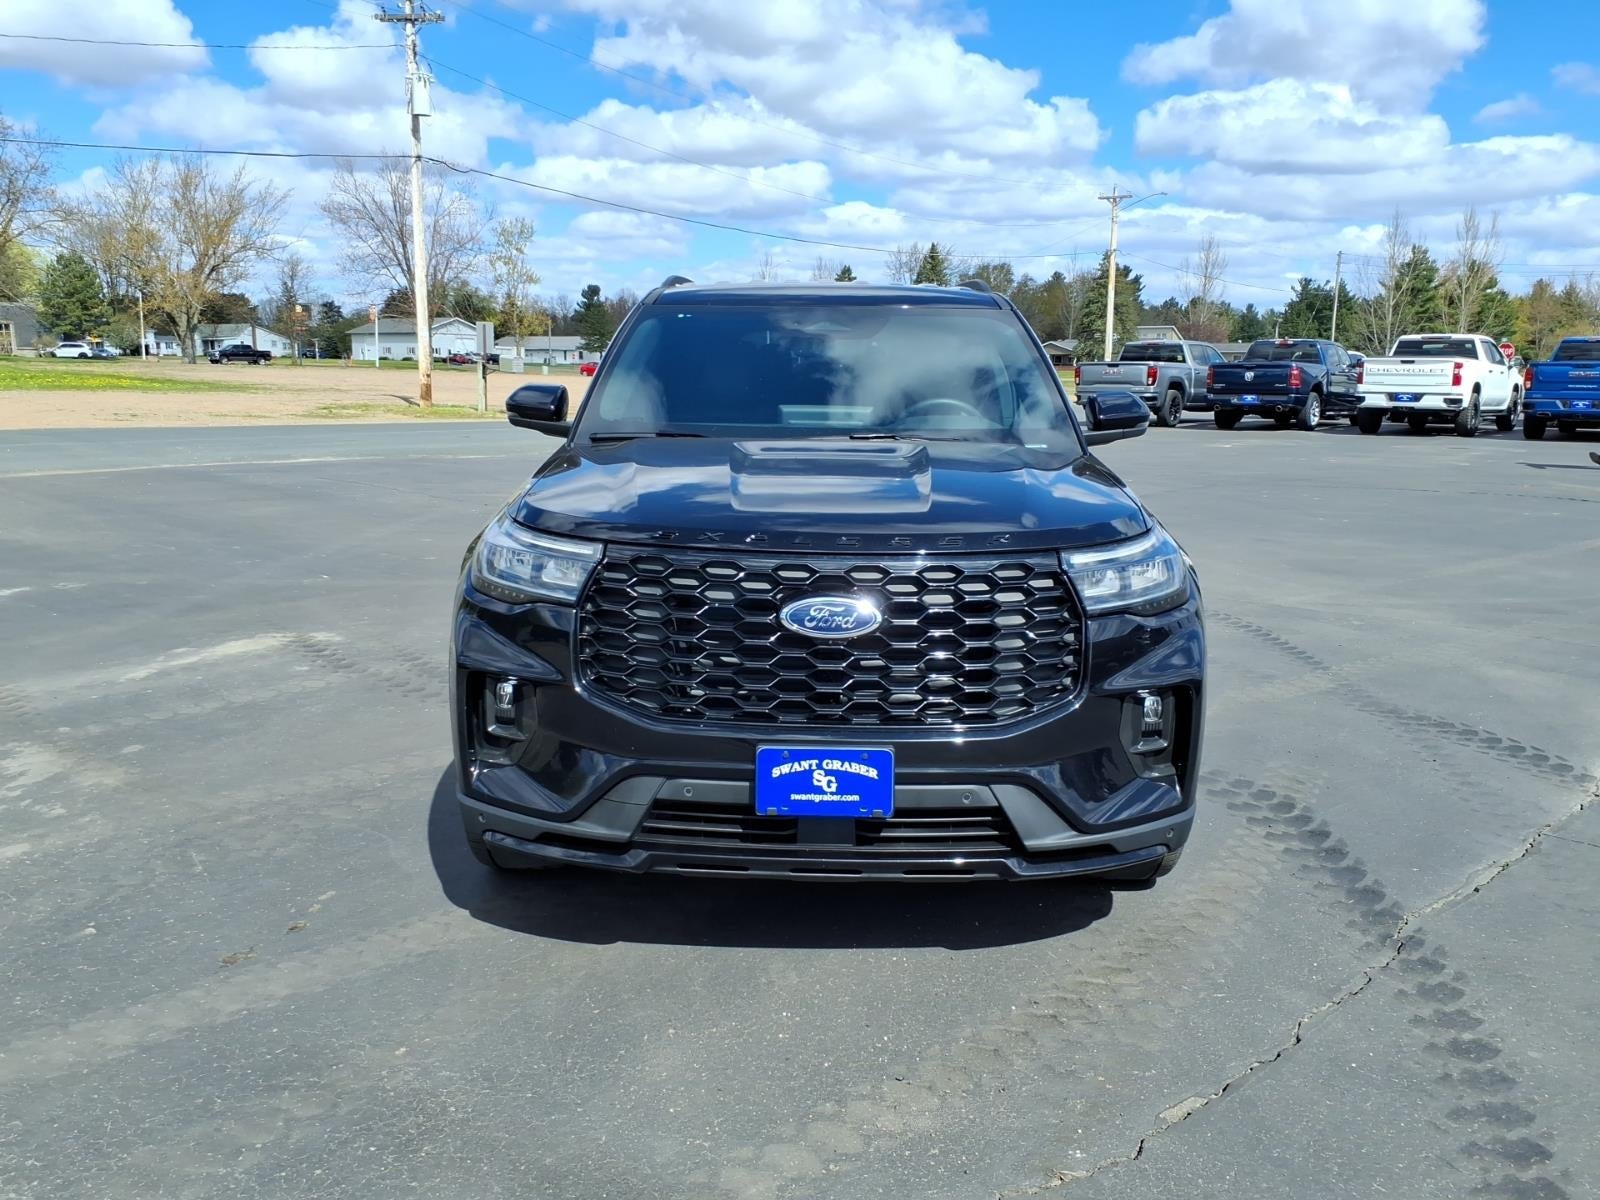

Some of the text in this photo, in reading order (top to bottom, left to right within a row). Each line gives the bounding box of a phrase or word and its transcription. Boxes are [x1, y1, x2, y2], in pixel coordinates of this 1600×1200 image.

[804, 605, 858, 628] Ford
[771, 759, 880, 780] SWANT GRABER
[812, 769, 838, 793] SG
[790, 792, 860, 803] swantgraber.com
